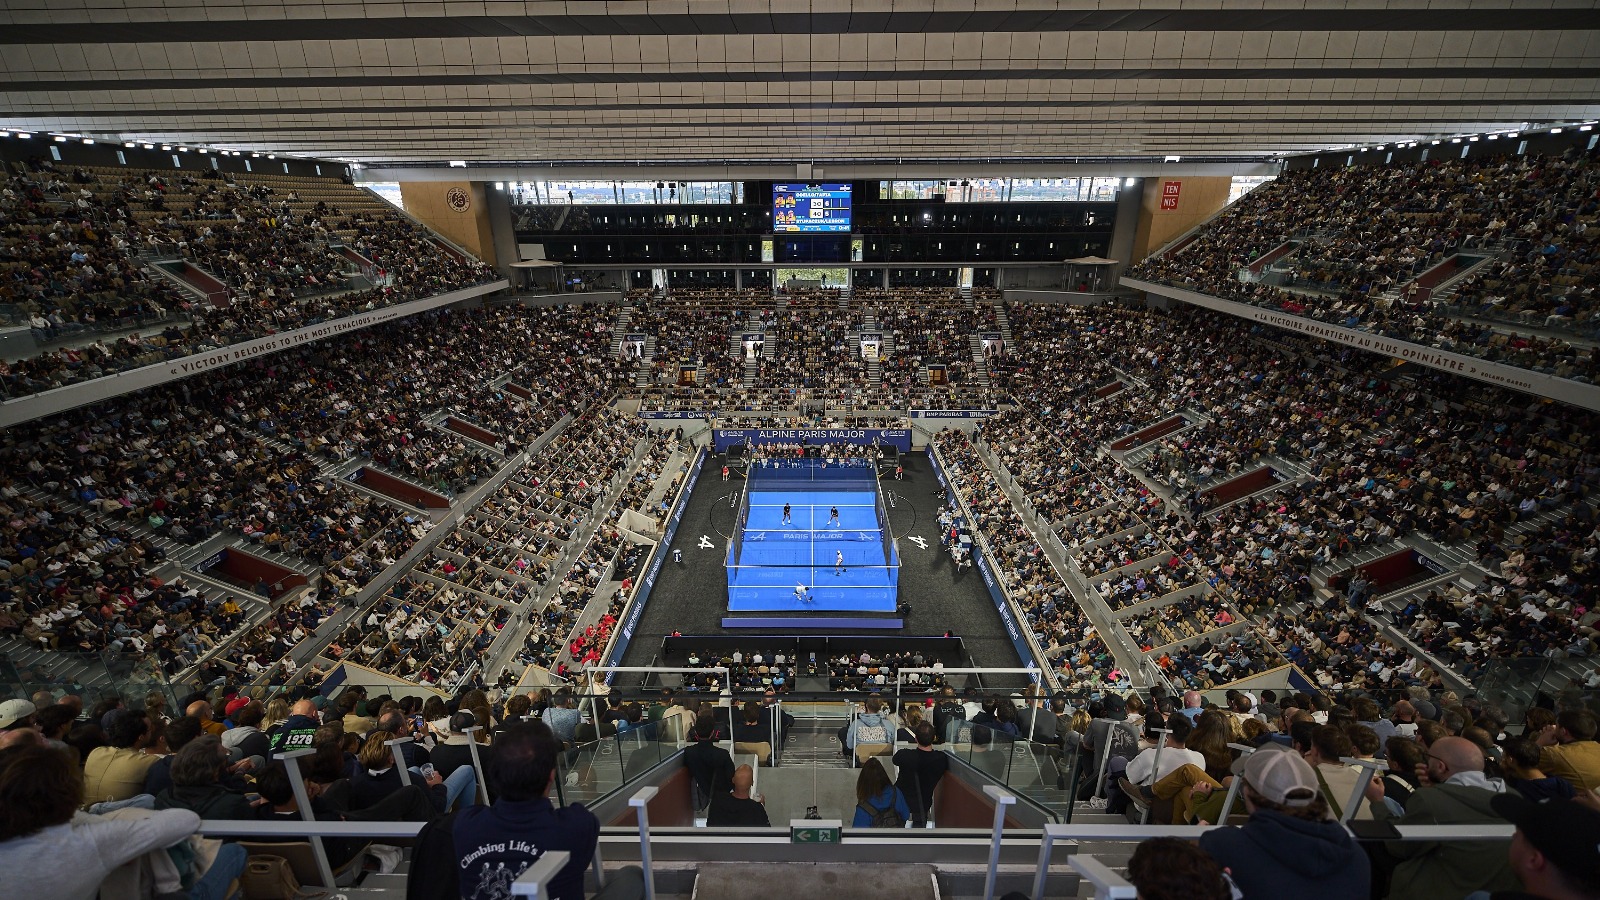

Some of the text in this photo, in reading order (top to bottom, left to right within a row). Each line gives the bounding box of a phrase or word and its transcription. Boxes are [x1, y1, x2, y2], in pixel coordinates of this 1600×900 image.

[1165, 185, 1179, 194] TEN
[1163, 198, 1176, 207] NIS
[181, 353, 229, 372] VICTORY
[233, 341, 277, 359] BELONGS
[279, 337, 291, 346] TO
[294, 332, 309, 343] THE
[311, 326, 332, 337] MOST
[333, 316, 371, 332] TENACIOUS
[1270, 316, 1303, 330] VICTOIRE
[1304, 323, 1356, 343] APPARTIENT
[1358, 338, 1371, 347] AU
[1373, 341, 1398, 354] PLUS
[1402, 348, 1465, 371] OPINIÂTRE
[1480, 371, 1505, 382] ROLAND
[1506, 378, 1532, 389] GARROS
[759, 430, 866, 438] ALPINE PARIS MAJOR
[285, 734, 314, 745] 1978
[460, 840, 539, 869] Climbing Life's
